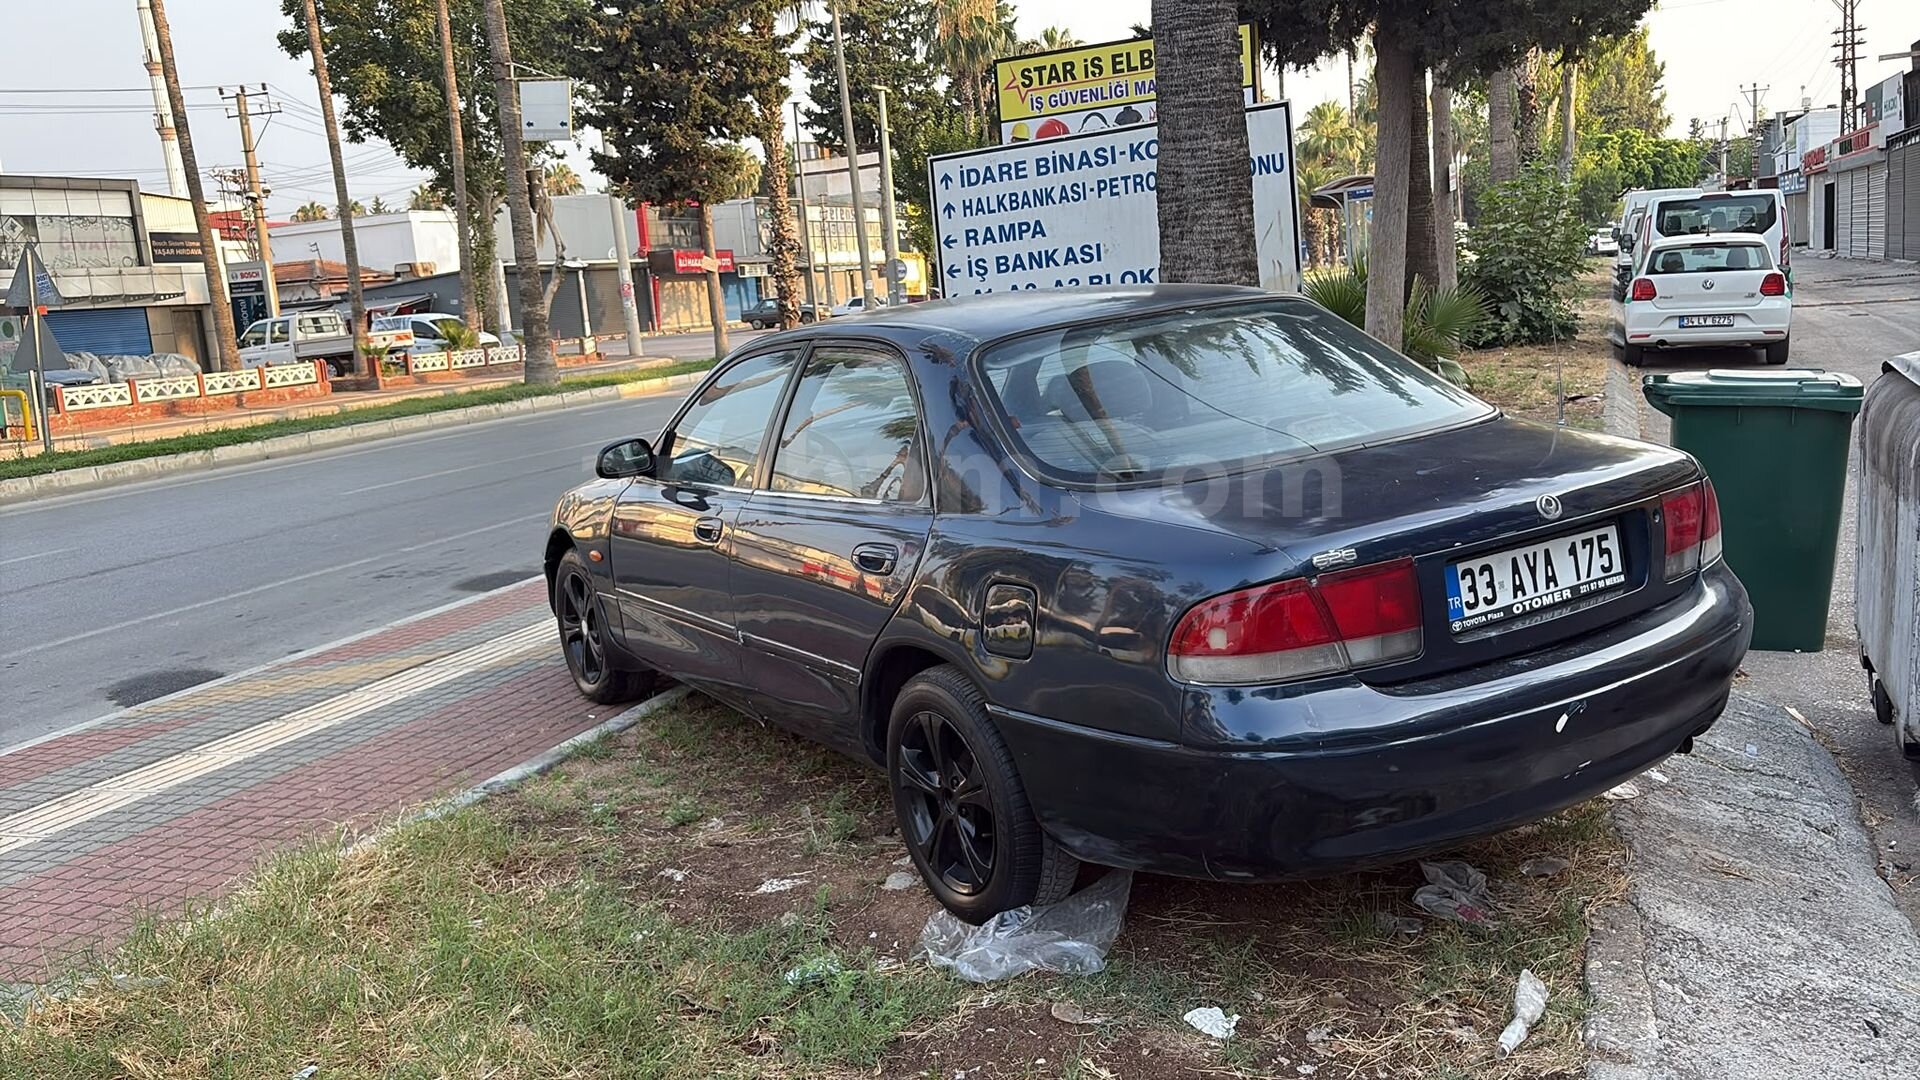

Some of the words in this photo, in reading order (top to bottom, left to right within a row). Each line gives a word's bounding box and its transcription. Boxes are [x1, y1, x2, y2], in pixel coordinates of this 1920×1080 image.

[1020, 60, 1076, 89] STAR
[1048, 79, 1129, 109] GÜVENLİĞİ
[959, 159, 1028, 188] İDARE
[964, 219, 1047, 247] RAMPA
[239, 271, 260, 279] BOSCH
[967, 255, 988, 282] İŞ
[995, 243, 1102, 274] BANKASI
[1685, 315, 1695, 325] 34
[1697, 315, 1708, 325] LV
[1712, 315, 1733, 325] 6275
[1448, 597, 1462, 611] TR
[1461, 563, 1498, 610] 33
[1511, 547, 1559, 600] AYA
[1568, 533, 1613, 582] 175
[1463, 615, 1487, 627] TOYOTA
[1487, 611, 1504, 622] Plaza
[1512, 589, 1572, 614] OTOMER
[1579, 584, 1590, 594] 221
